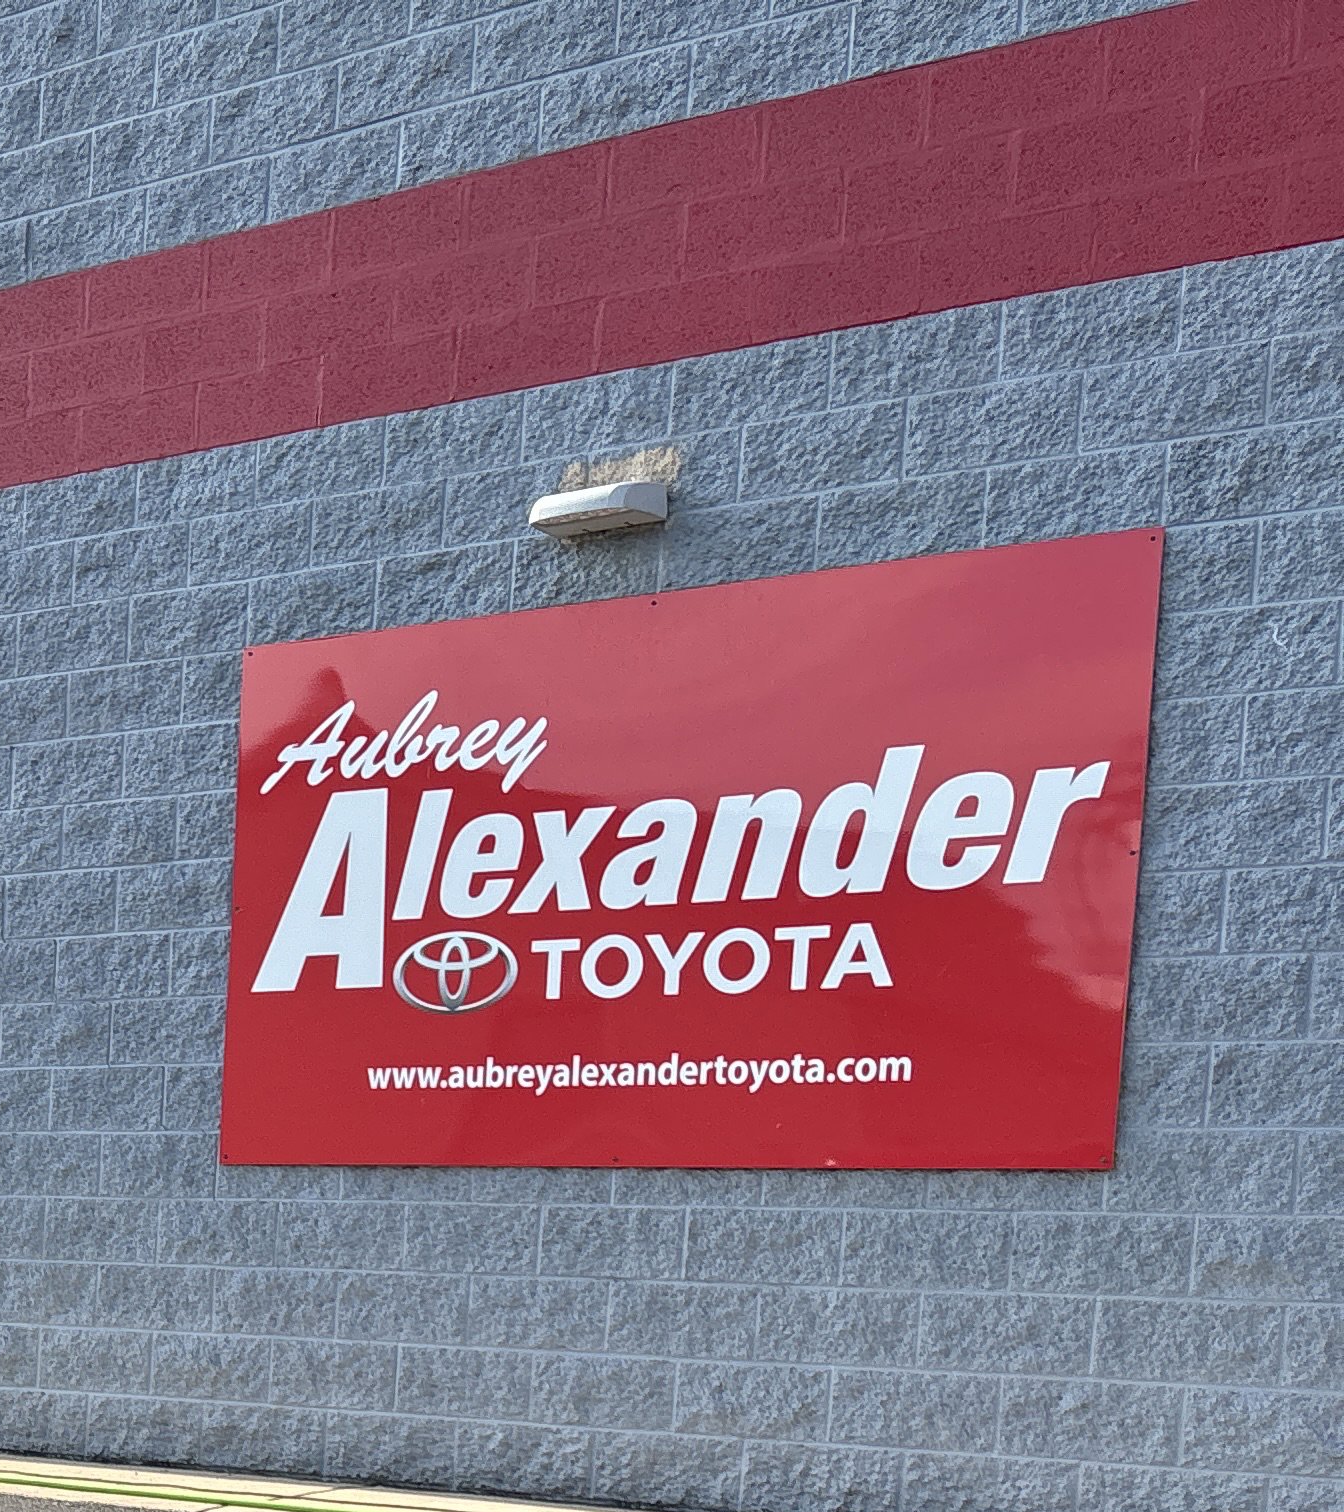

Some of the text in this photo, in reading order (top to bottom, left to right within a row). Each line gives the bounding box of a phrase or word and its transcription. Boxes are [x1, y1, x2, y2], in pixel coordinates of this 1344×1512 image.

[260, 689, 548, 796] Aubrey
[250, 744, 1111, 993] Alexander
[530, 922, 894, 1000] TOYOTA
[367, 1052, 913, 1096] www.aubreyalexandertoyota.com
